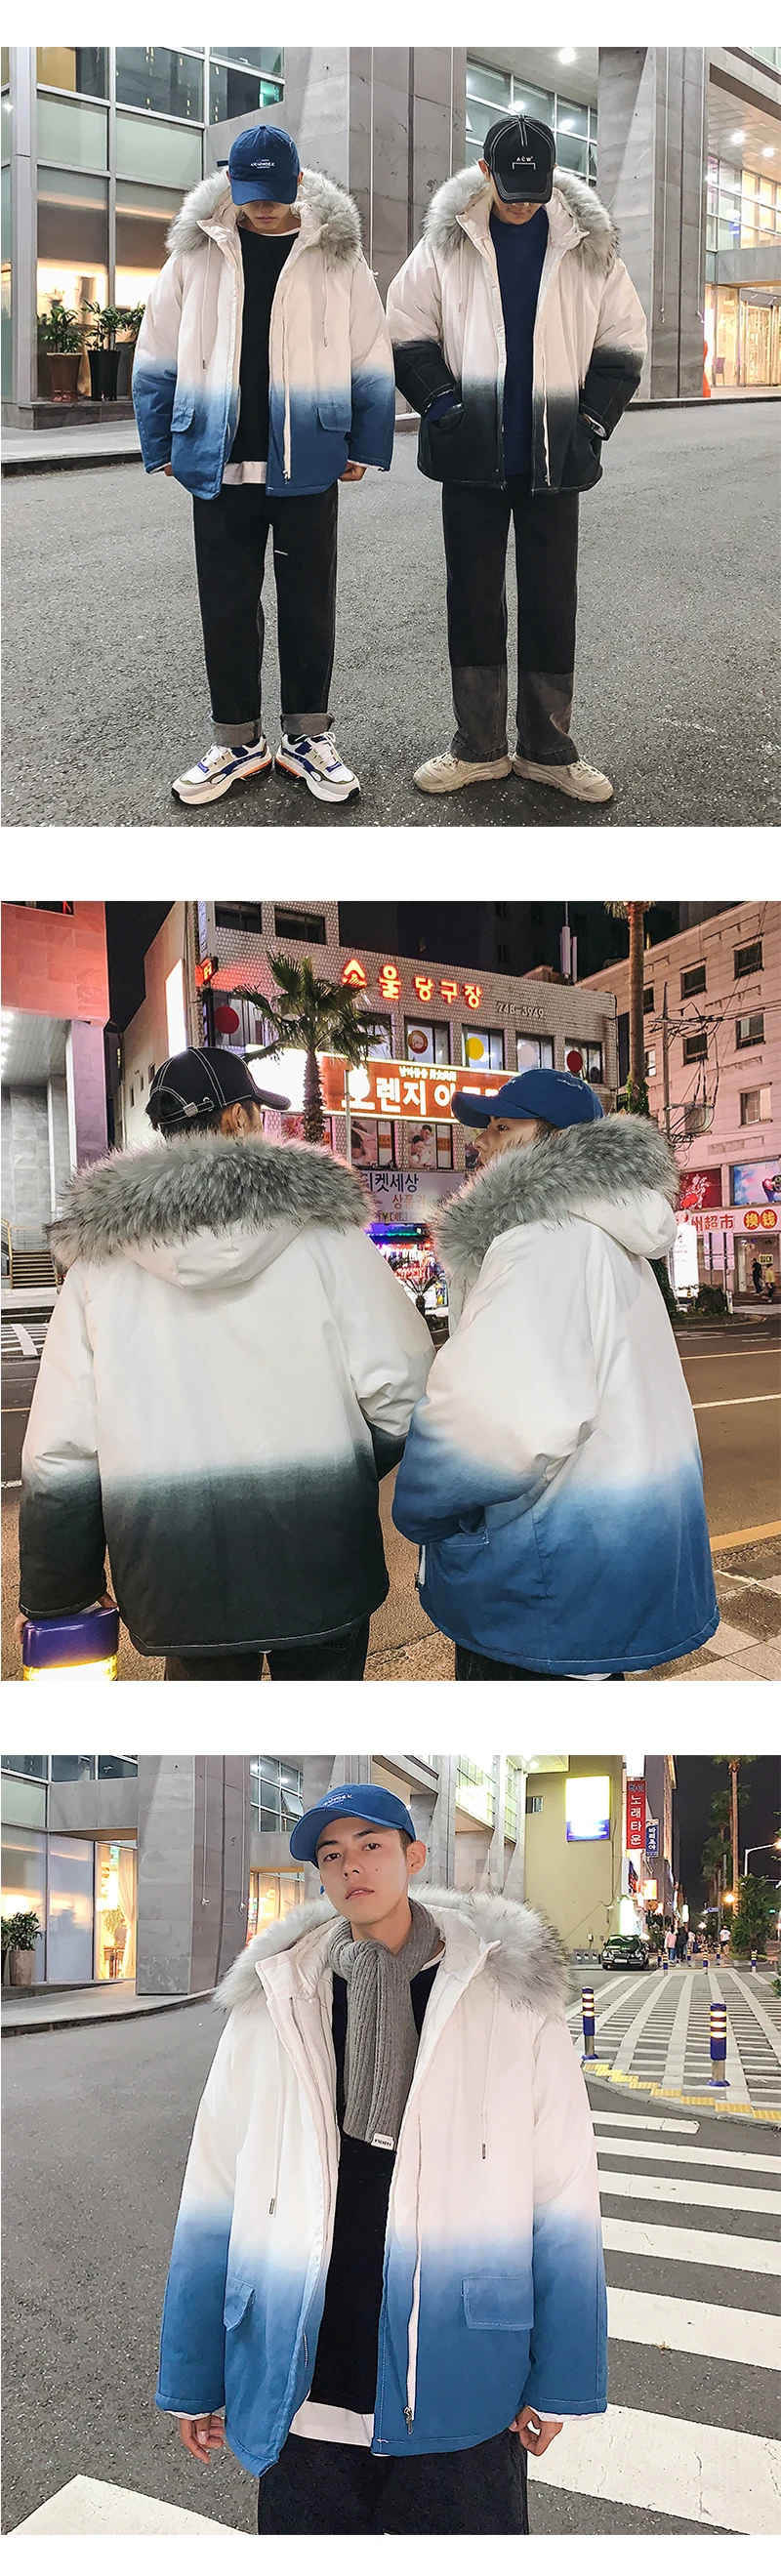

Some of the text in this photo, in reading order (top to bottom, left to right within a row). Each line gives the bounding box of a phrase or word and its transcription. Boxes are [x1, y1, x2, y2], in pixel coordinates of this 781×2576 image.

[414, 976, 482, 1008] 당구장
[497, 1002, 544, 1018] 748-3949
[342, 1067, 427, 1116] 오렌지
[630, 1794, 642, 1846] 노래타운
